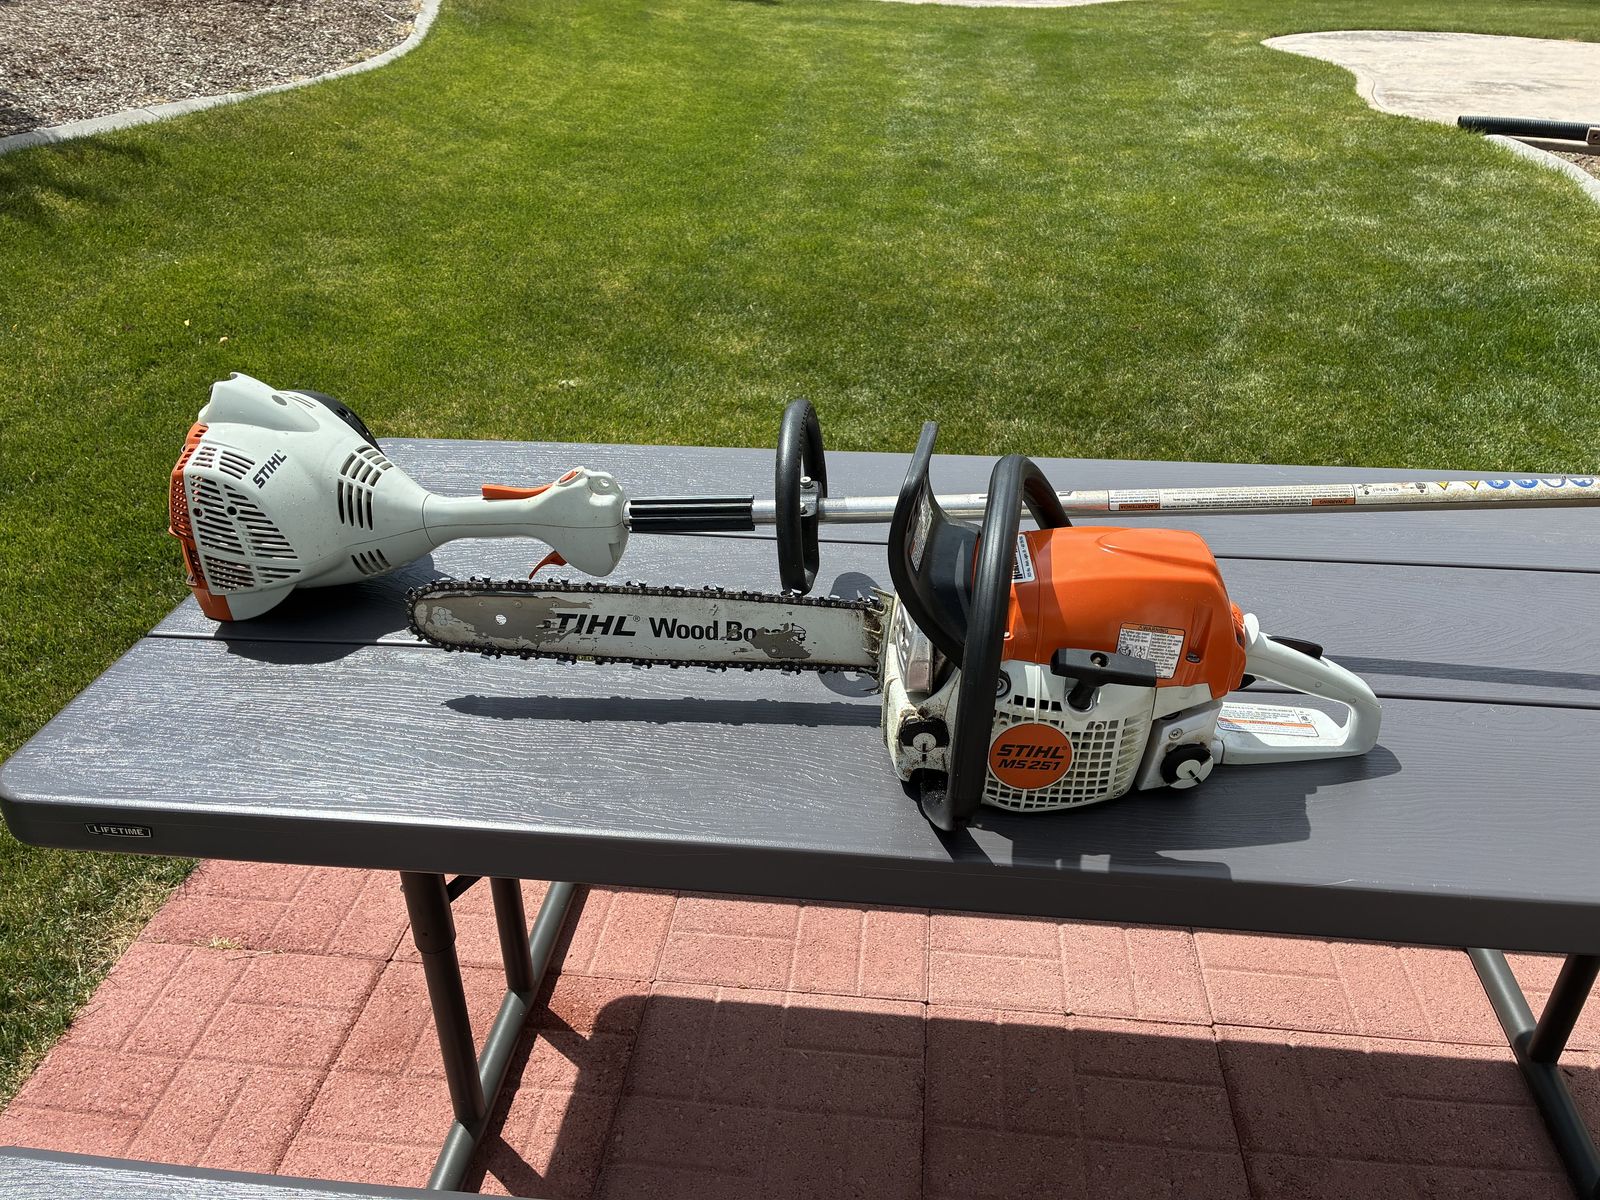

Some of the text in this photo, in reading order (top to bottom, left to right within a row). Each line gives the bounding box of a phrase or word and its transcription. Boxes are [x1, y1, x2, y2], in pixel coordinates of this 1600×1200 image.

[253, 453, 287, 489] STIHL
[649, 617, 718, 640] Wood
[997, 744, 1064, 759] STIHL
[94, 826, 144, 836] LIFETIME
